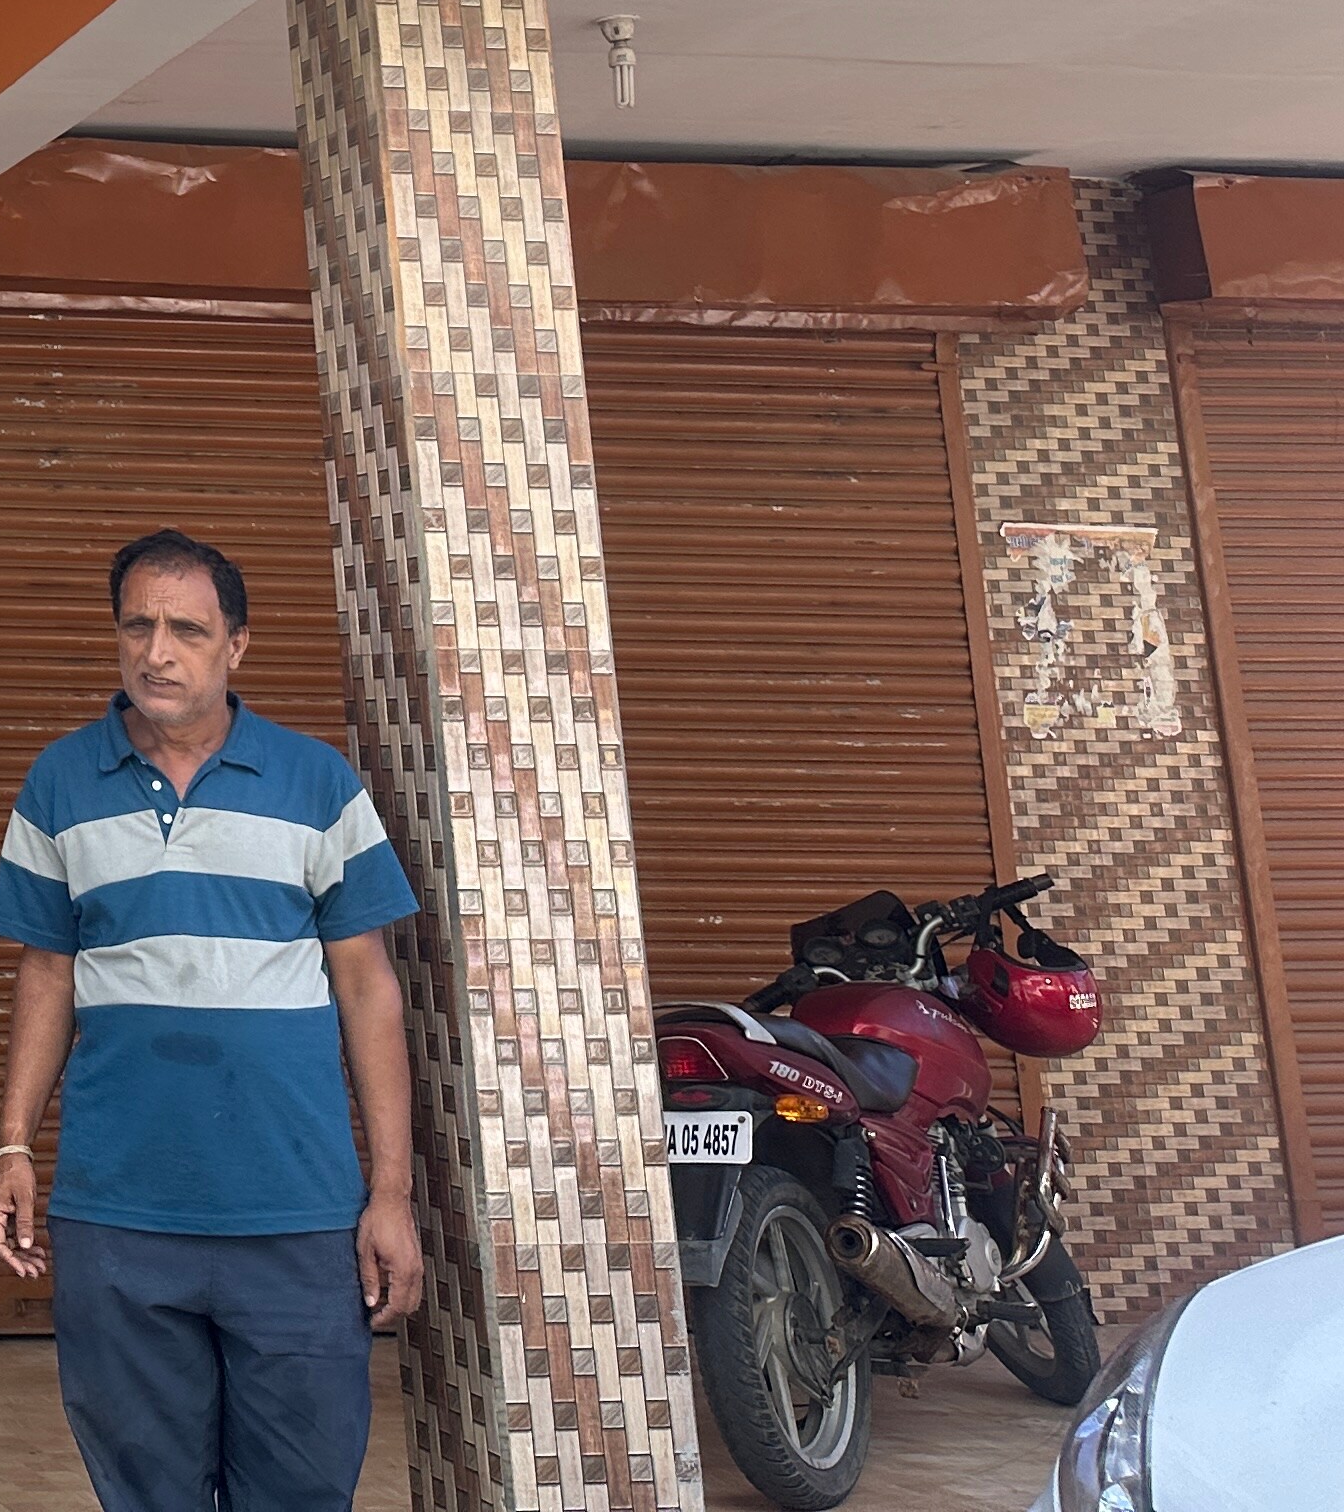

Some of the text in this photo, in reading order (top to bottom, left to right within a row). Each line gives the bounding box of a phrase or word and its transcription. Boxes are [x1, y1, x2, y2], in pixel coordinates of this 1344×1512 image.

[769, 1060, 800, 1082] 180
[664, 1123, 739, 1156] A 05 4857
